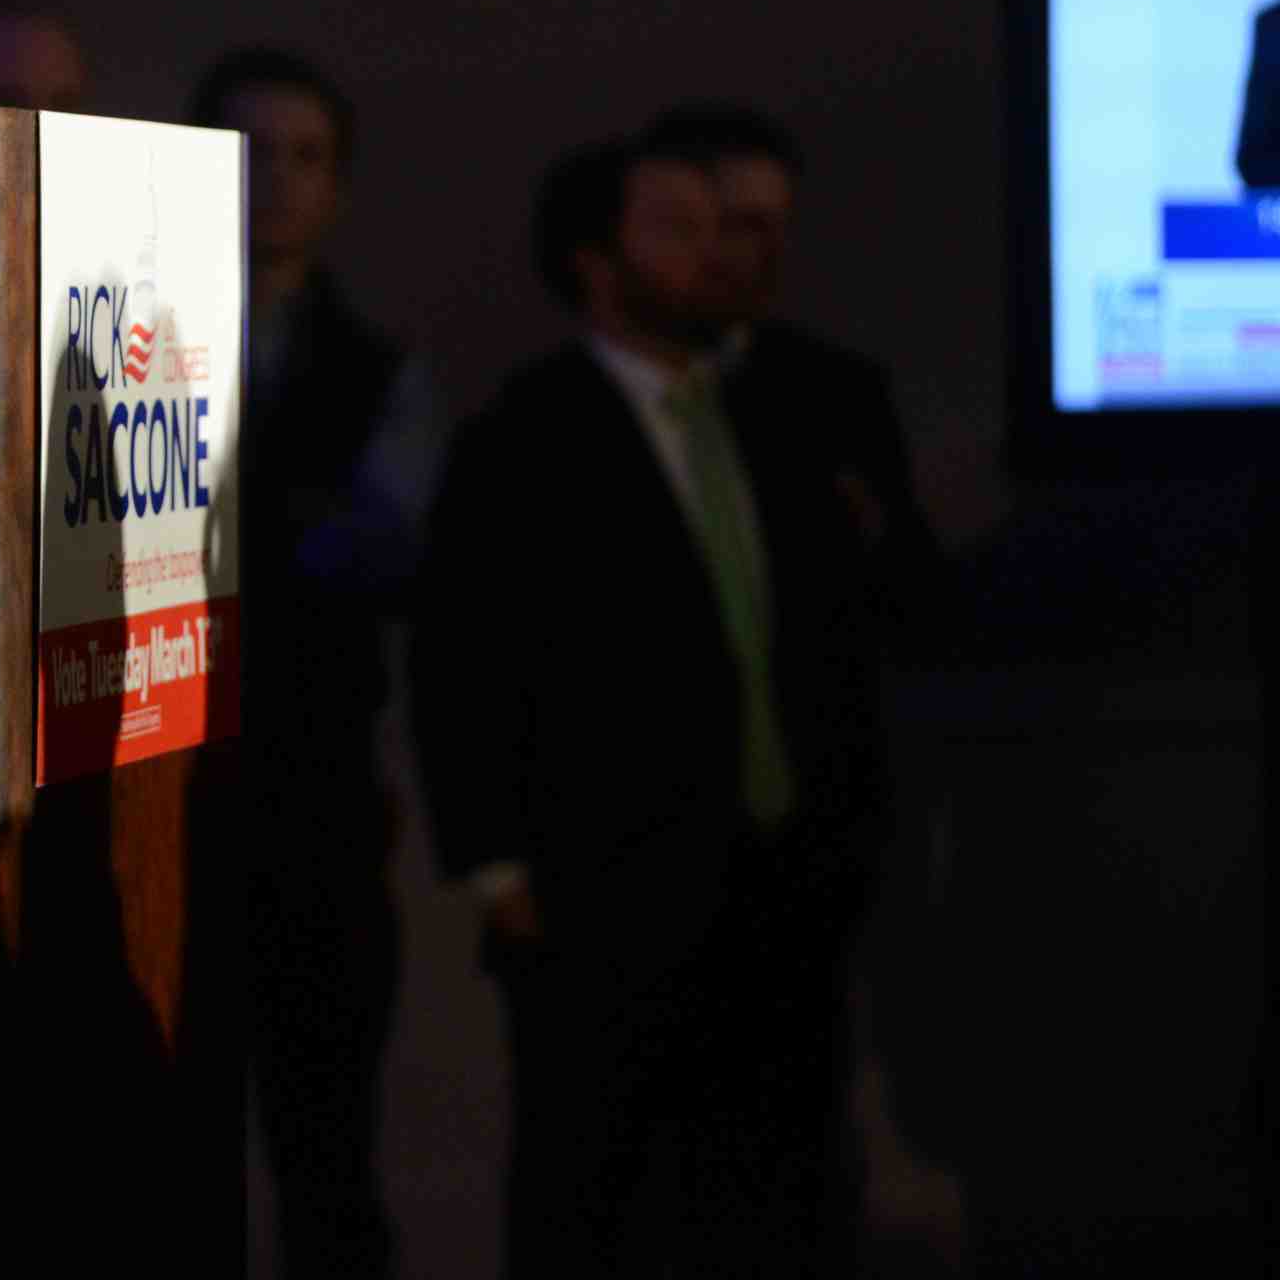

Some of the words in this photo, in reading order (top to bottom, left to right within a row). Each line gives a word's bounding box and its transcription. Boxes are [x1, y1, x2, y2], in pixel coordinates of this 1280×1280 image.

[66, 285, 128, 392] RICK
[64, 397, 209, 528] SACCONE
[52, 646, 86, 708] Vote
[88, 632, 149, 703] Tuesday
[150, 618, 196, 686] March
